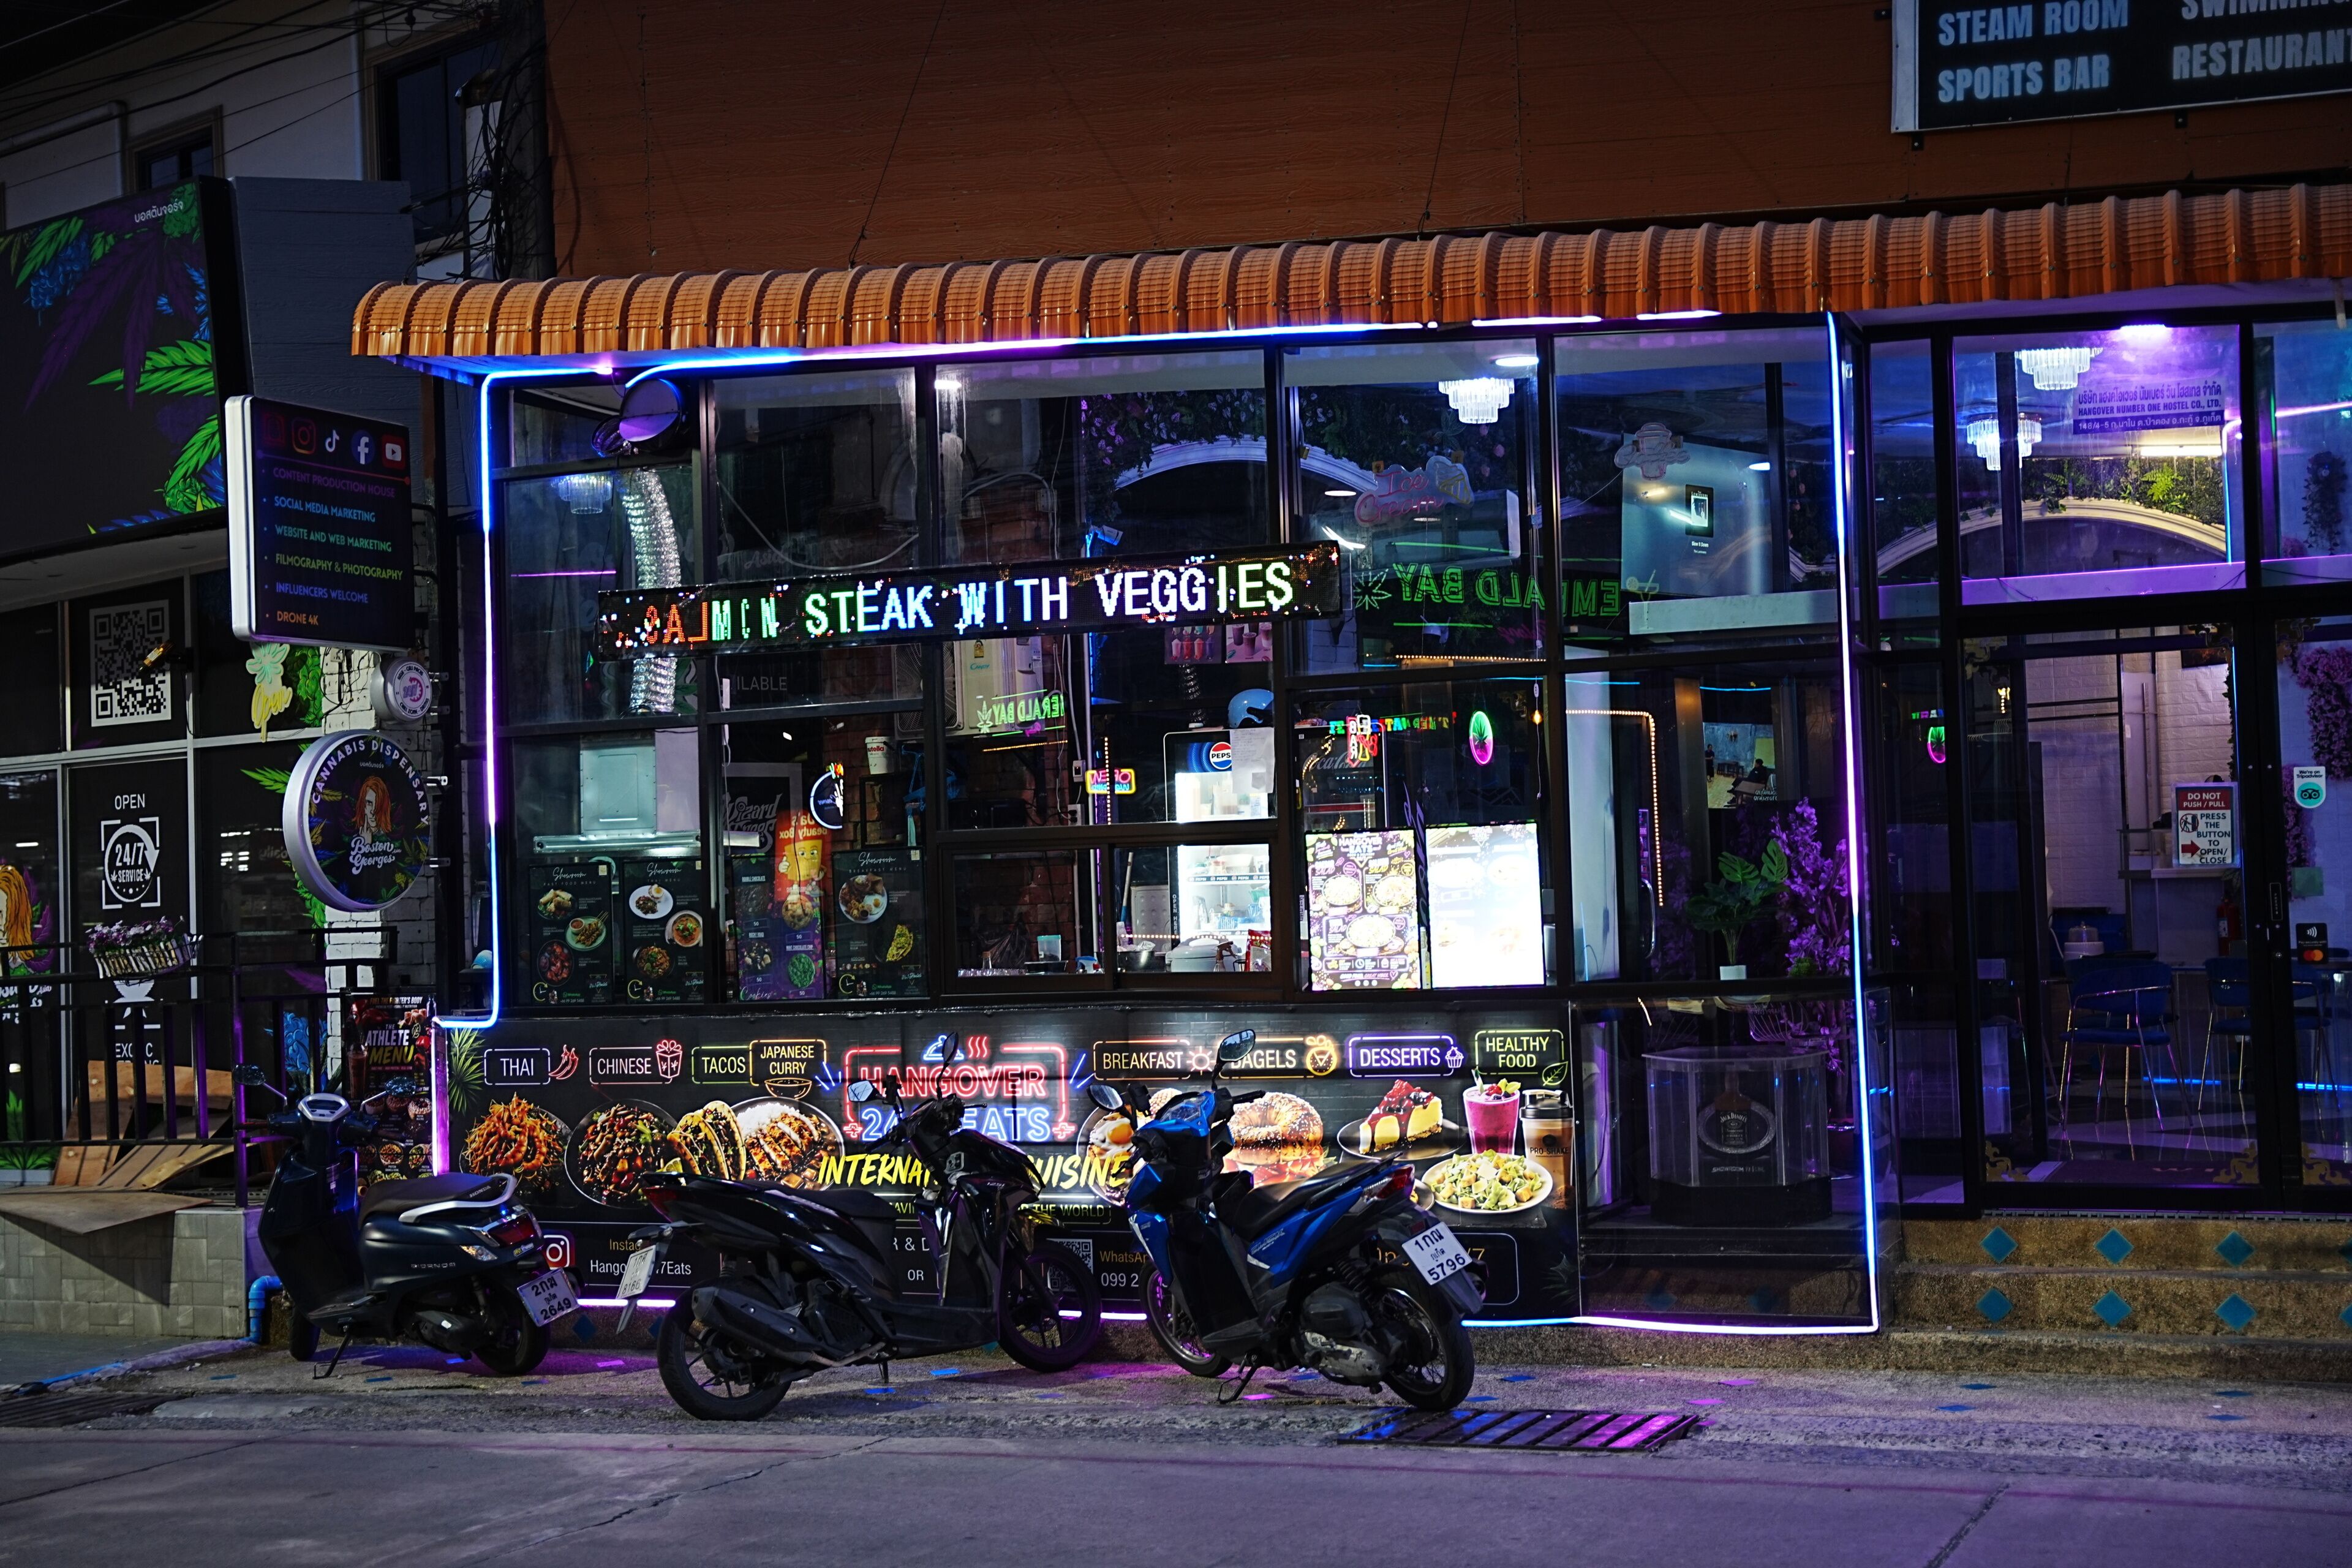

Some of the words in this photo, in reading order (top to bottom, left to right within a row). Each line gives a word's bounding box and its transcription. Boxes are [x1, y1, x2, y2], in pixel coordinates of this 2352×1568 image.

[1939, 4, 2033, 46] STEAM
[2044, 0, 2128, 36] ROOM
[1938, 61, 2043, 104] SPORTS
[2054, 53, 2111, 93] BAR
[2078, 404, 2115, 417] HANGOVER
[2117, 403, 2146, 415] NUMBER
[2147, 402, 2161, 412] ONE
[2163, 400, 2189, 411] HOSTEL
[2191, 399, 2205, 410] CO.,
[2207, 398, 2222, 408] LTD.
[273, 467, 312, 486] CONTENT
[312, 473, 366, 494] PRODUCTION
[368, 484, 396, 499] HOUSE
[1375, 470, 1430, 498] Ice
[274, 495, 304, 511] SOCIAL
[305, 501, 329, 516] MEDIA
[331, 507, 376, 522] MARKETING
[1357, 494, 1444, 523] Cream
[275, 524, 307, 540] WEBSITE
[309, 531, 326, 543] AND
[328, 533, 345, 546] WEB
[347, 537, 392, 552] MARKETING
[276, 553, 333, 572] FILMOGRAPHY
[334, 562, 341, 572] &
[342, 563, 404, 581] PHOTOGRAPHY
[276, 582, 329, 599] INFLUENCERS
[330, 589, 369, 604] WELCOME
[805, 586, 934, 635] STEAK
[959, 576, 1068, 626] WITH
[1095, 561, 1293, 617] VEGGIES
[277, 610, 307, 624] DRONE
[308, 614, 319, 625] 4K
[311, 739, 366, 804] CANNABIS
[371, 740, 429, 825] DISPENSARY
[114, 793, 146, 810] OPEN
[2187, 792, 2202, 801] DO
[2203, 792, 2222, 801] NOT
[2200, 812, 2227, 821] PRESS
[1338, 837, 1383, 846] HANGOVER
[2196, 830, 2231, 839] BUTTON
[115, 842, 145, 867] 24/7
[350, 835, 394, 856] Boston
[1349, 845, 1374, 854] EATS
[2199, 848, 2228, 856] OPEN/
[349, 853, 396, 875] Georges
[858, 851, 897, 867] Showroom
[2199, 856, 2227, 865] CLOSE
[118, 870, 144, 883] SERVICE
[552, 866, 587, 881] Showroom
[646, 862, 682, 877] Showroom
[740, 985, 772, 1000] Cookies
[364, 1029, 410, 1047] ATHLETE
[1485, 1035, 1550, 1054] HEALTHY
[369, 1044, 415, 1065] MENU
[760, 1045, 815, 1060] JAPANESE
[1102, 1051, 1184, 1070] BREAKFAST
[1360, 1046, 1441, 1068] DESSERTS
[1498, 1054, 1537, 1068] FOOD
[500, 1057, 535, 1077] THAI
[597, 1058, 652, 1076] CHINESE
[701, 1057, 747, 1075] TACOS
[769, 1061, 807, 1075] CURRY
[859, 1065, 1047, 1098] HANGOVER
[1529, 1147, 1544, 1155] PRO
[1546, 1147, 1569, 1155] SHAKE
[818, 1153, 933, 1186] INTERNA
[1035, 1155, 1128, 1189] UISINE
[469, 1185, 492, 1199] HONDA
[1033, 1204, 1056, 1218] THE
[1058, 1204, 1104, 1218] WORLD
[905, 1238, 916, 1252] &
[908, 1269, 924, 1281] OR
[1427, 1253, 1466, 1281] 5796
[622, 1278, 641, 1295] 8166
[1101, 1273, 1128, 1287] 099
[540, 1297, 572, 1321] 2649
